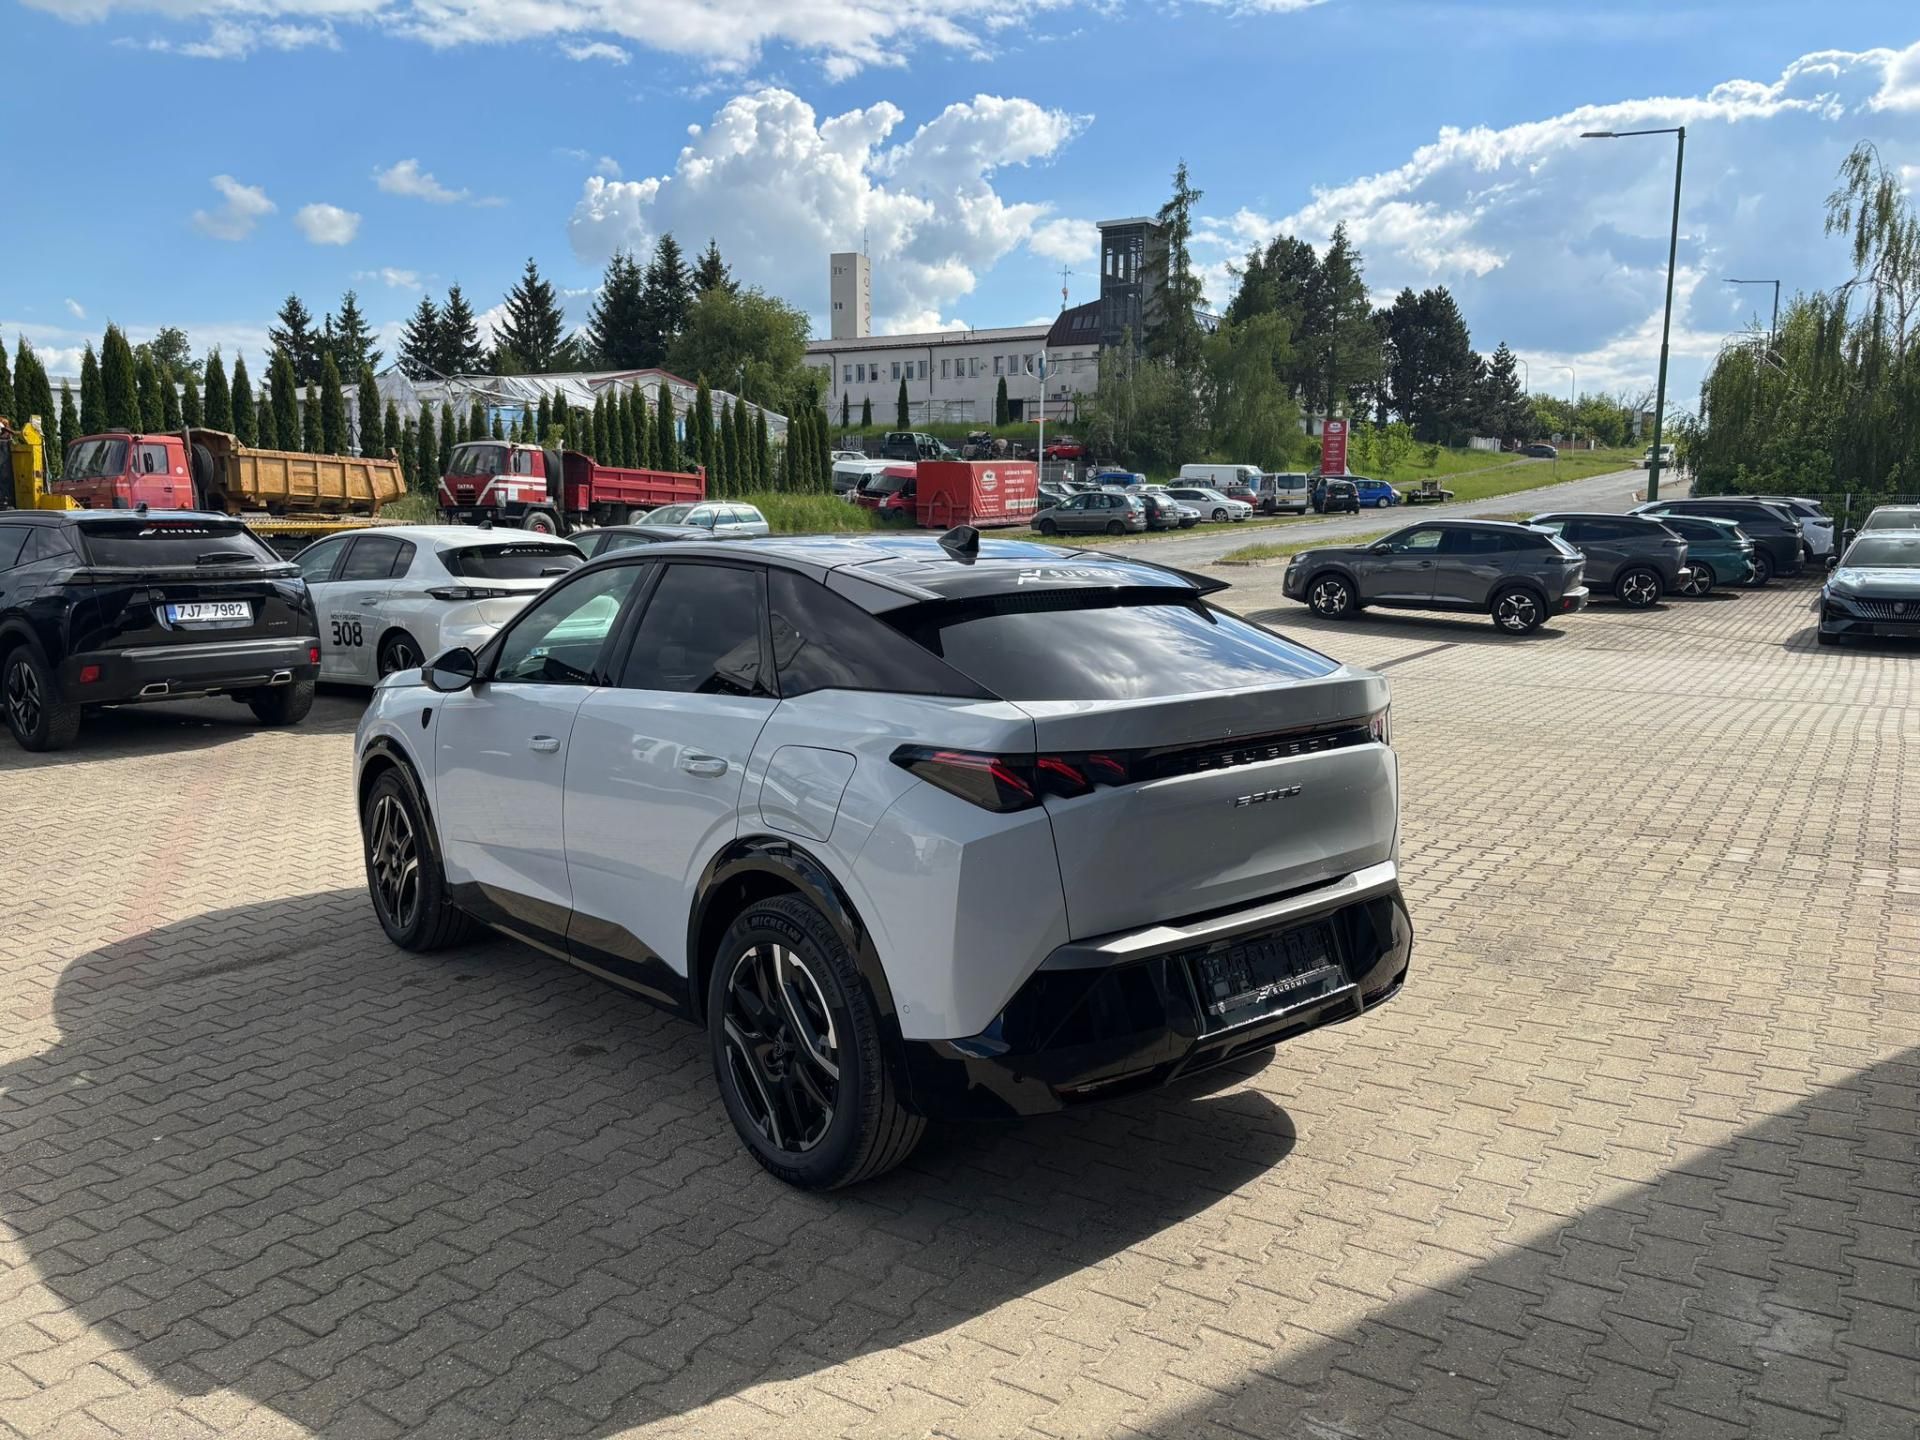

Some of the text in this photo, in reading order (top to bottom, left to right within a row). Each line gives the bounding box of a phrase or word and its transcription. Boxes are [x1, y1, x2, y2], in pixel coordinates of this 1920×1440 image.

[177, 603, 245, 619] 7J7 7982
[331, 620, 363, 647] 308
[751, 915, 801, 942] MICHELIN
[1272, 977, 1308, 996] SUDOMA
